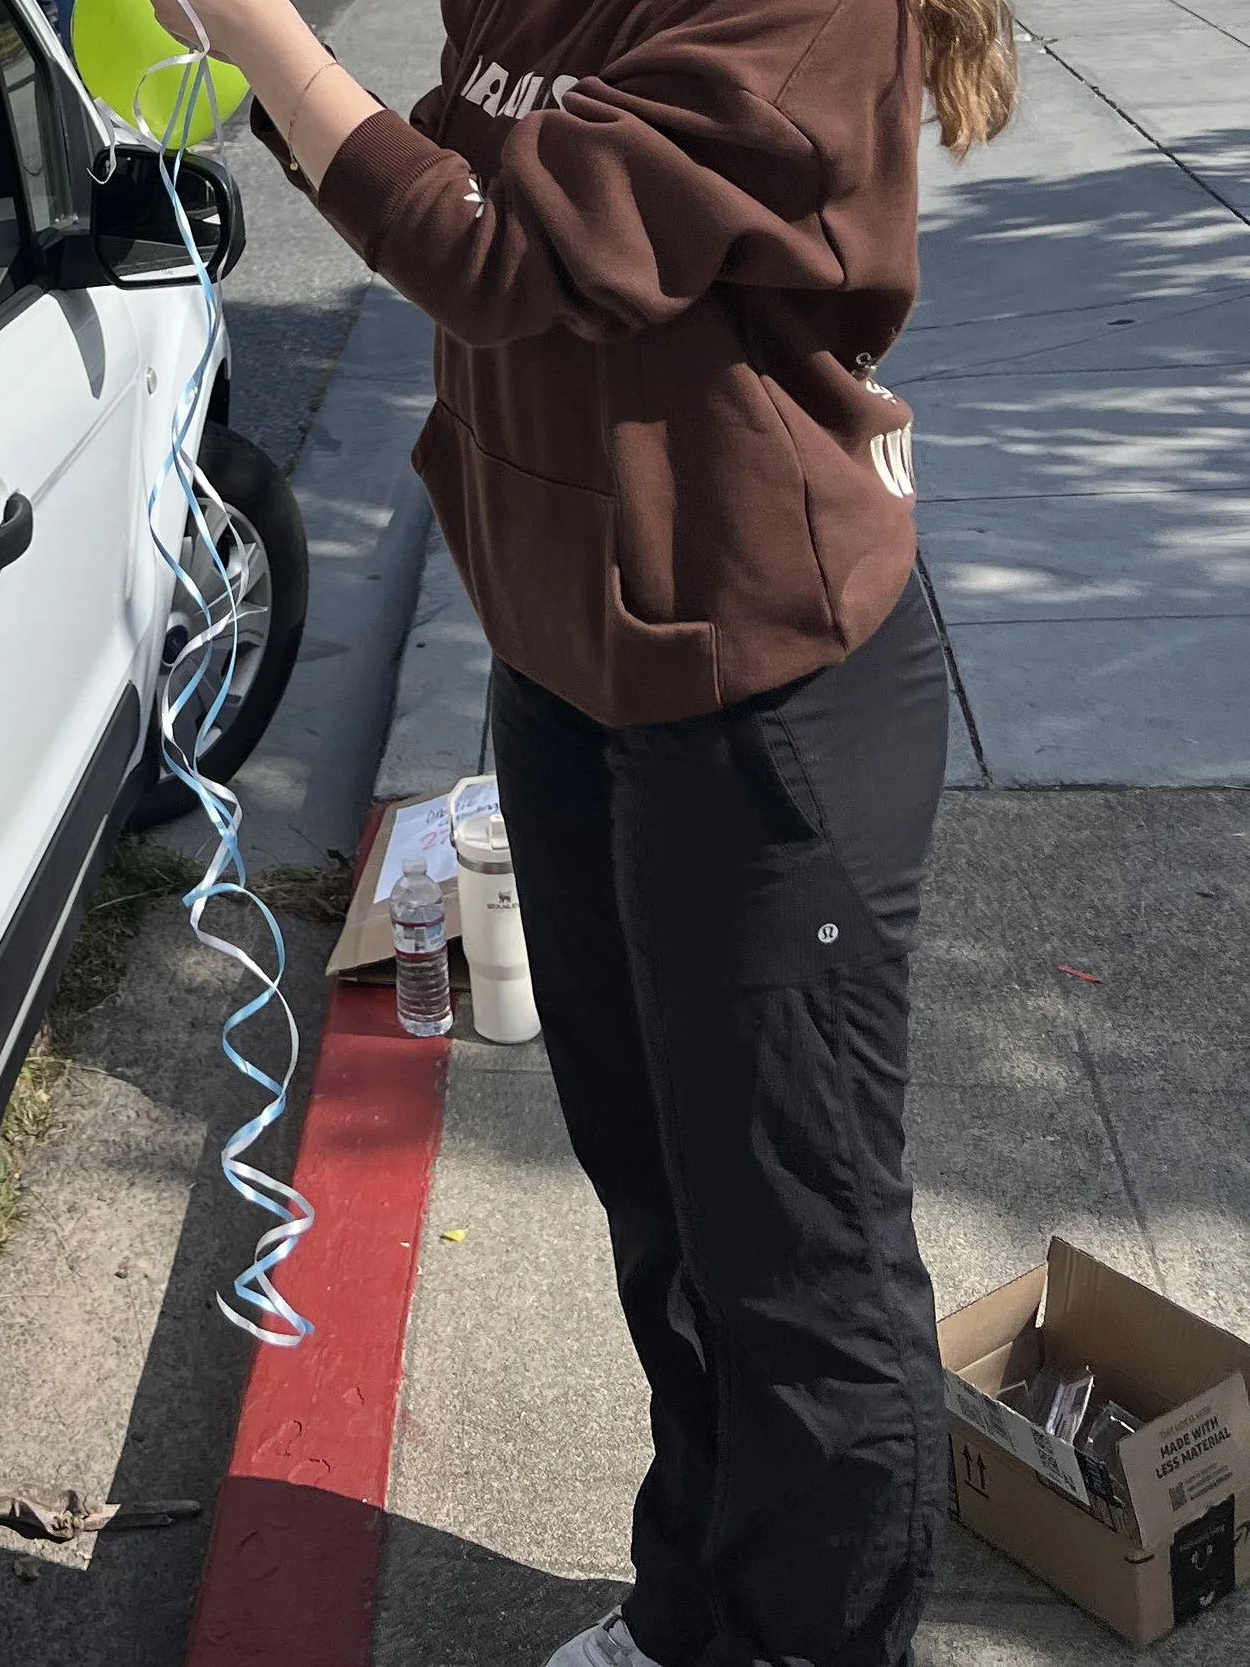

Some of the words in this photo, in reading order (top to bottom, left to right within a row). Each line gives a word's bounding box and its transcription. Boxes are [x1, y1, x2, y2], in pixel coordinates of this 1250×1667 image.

[1155, 1456, 1180, 1480] LESS
[1181, 1427, 1232, 1465] MATERIAL
[1159, 1433, 1191, 1460] MADE
[1191, 1415, 1219, 1441] WITH
